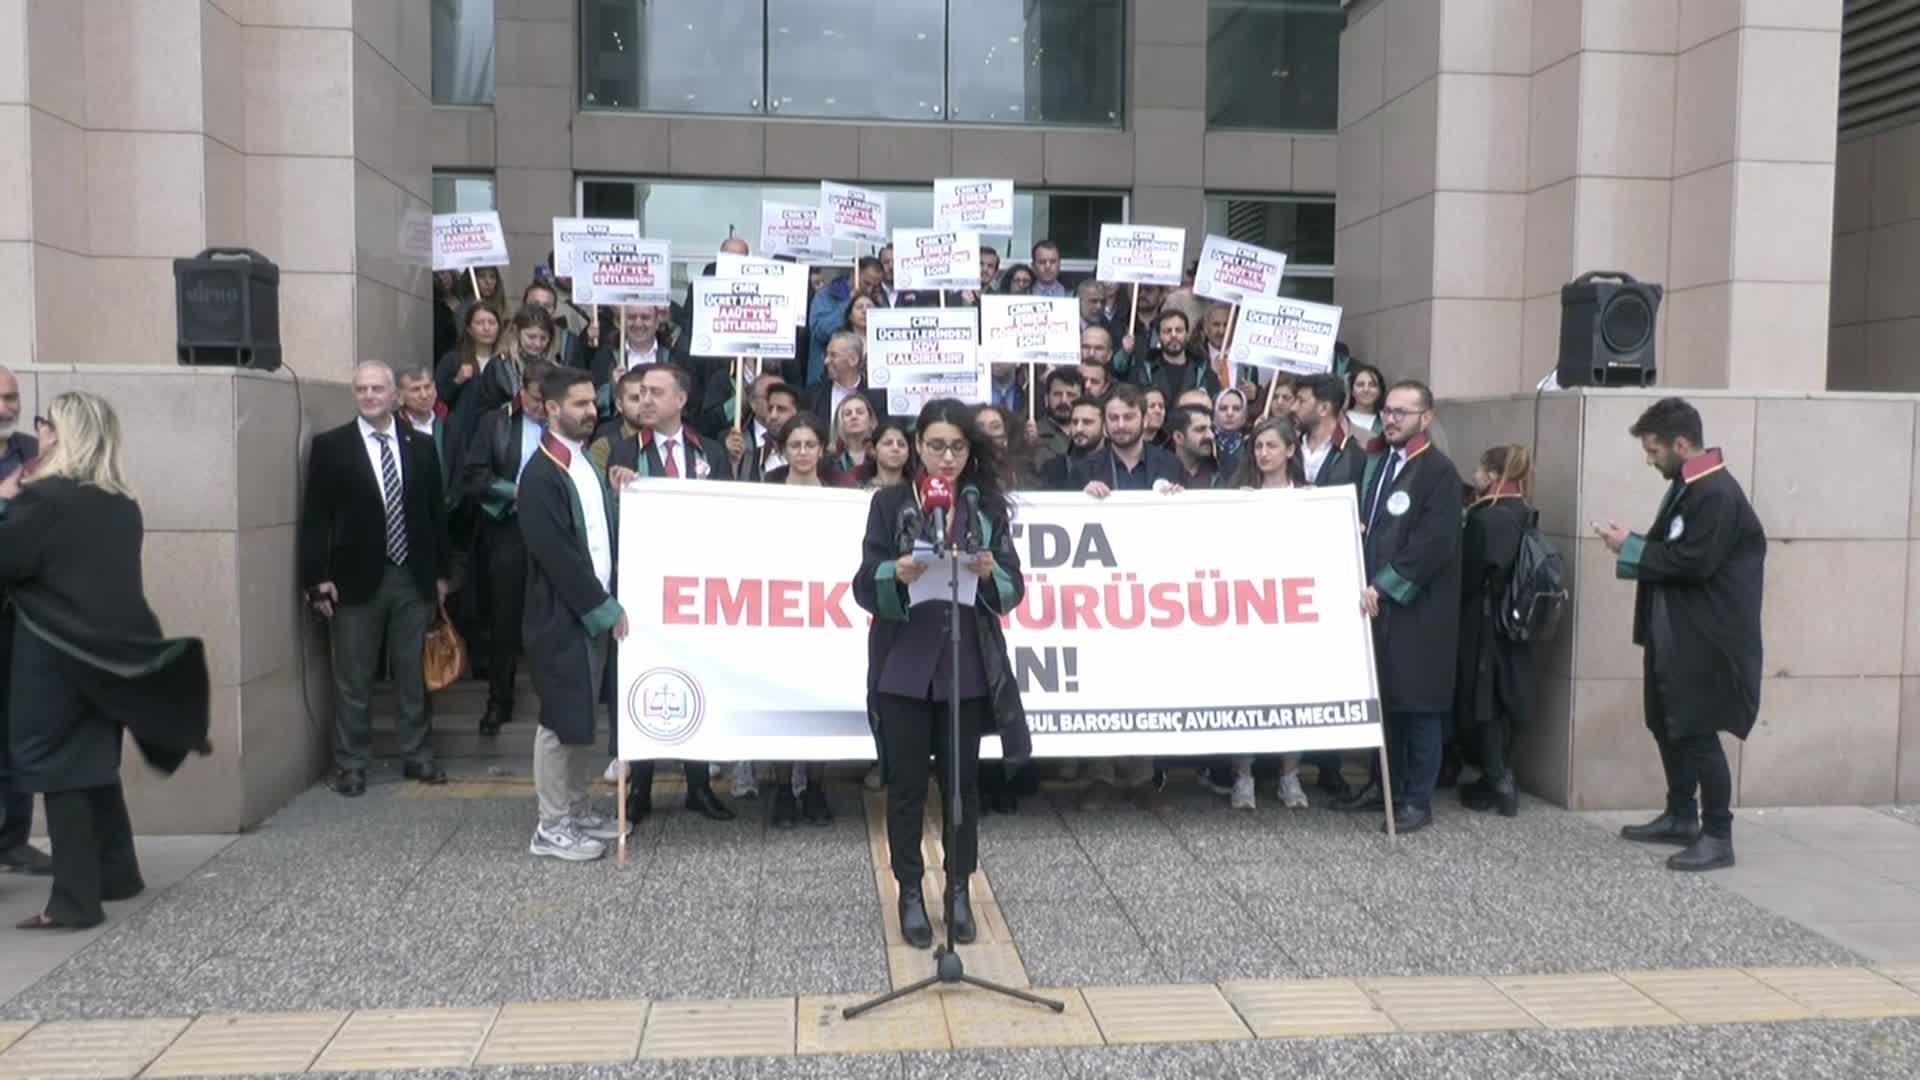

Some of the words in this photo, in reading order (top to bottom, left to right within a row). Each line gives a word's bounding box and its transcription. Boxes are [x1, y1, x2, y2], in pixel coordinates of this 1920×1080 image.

[662, 576, 853, 628] EMEK
[1060, 712, 1133, 732] BAROSU
[1135, 711, 1183, 735] GENÇ
[1185, 708, 1294, 730] AVUKATLAR
[1296, 700, 1368, 726] MECLİSİ
